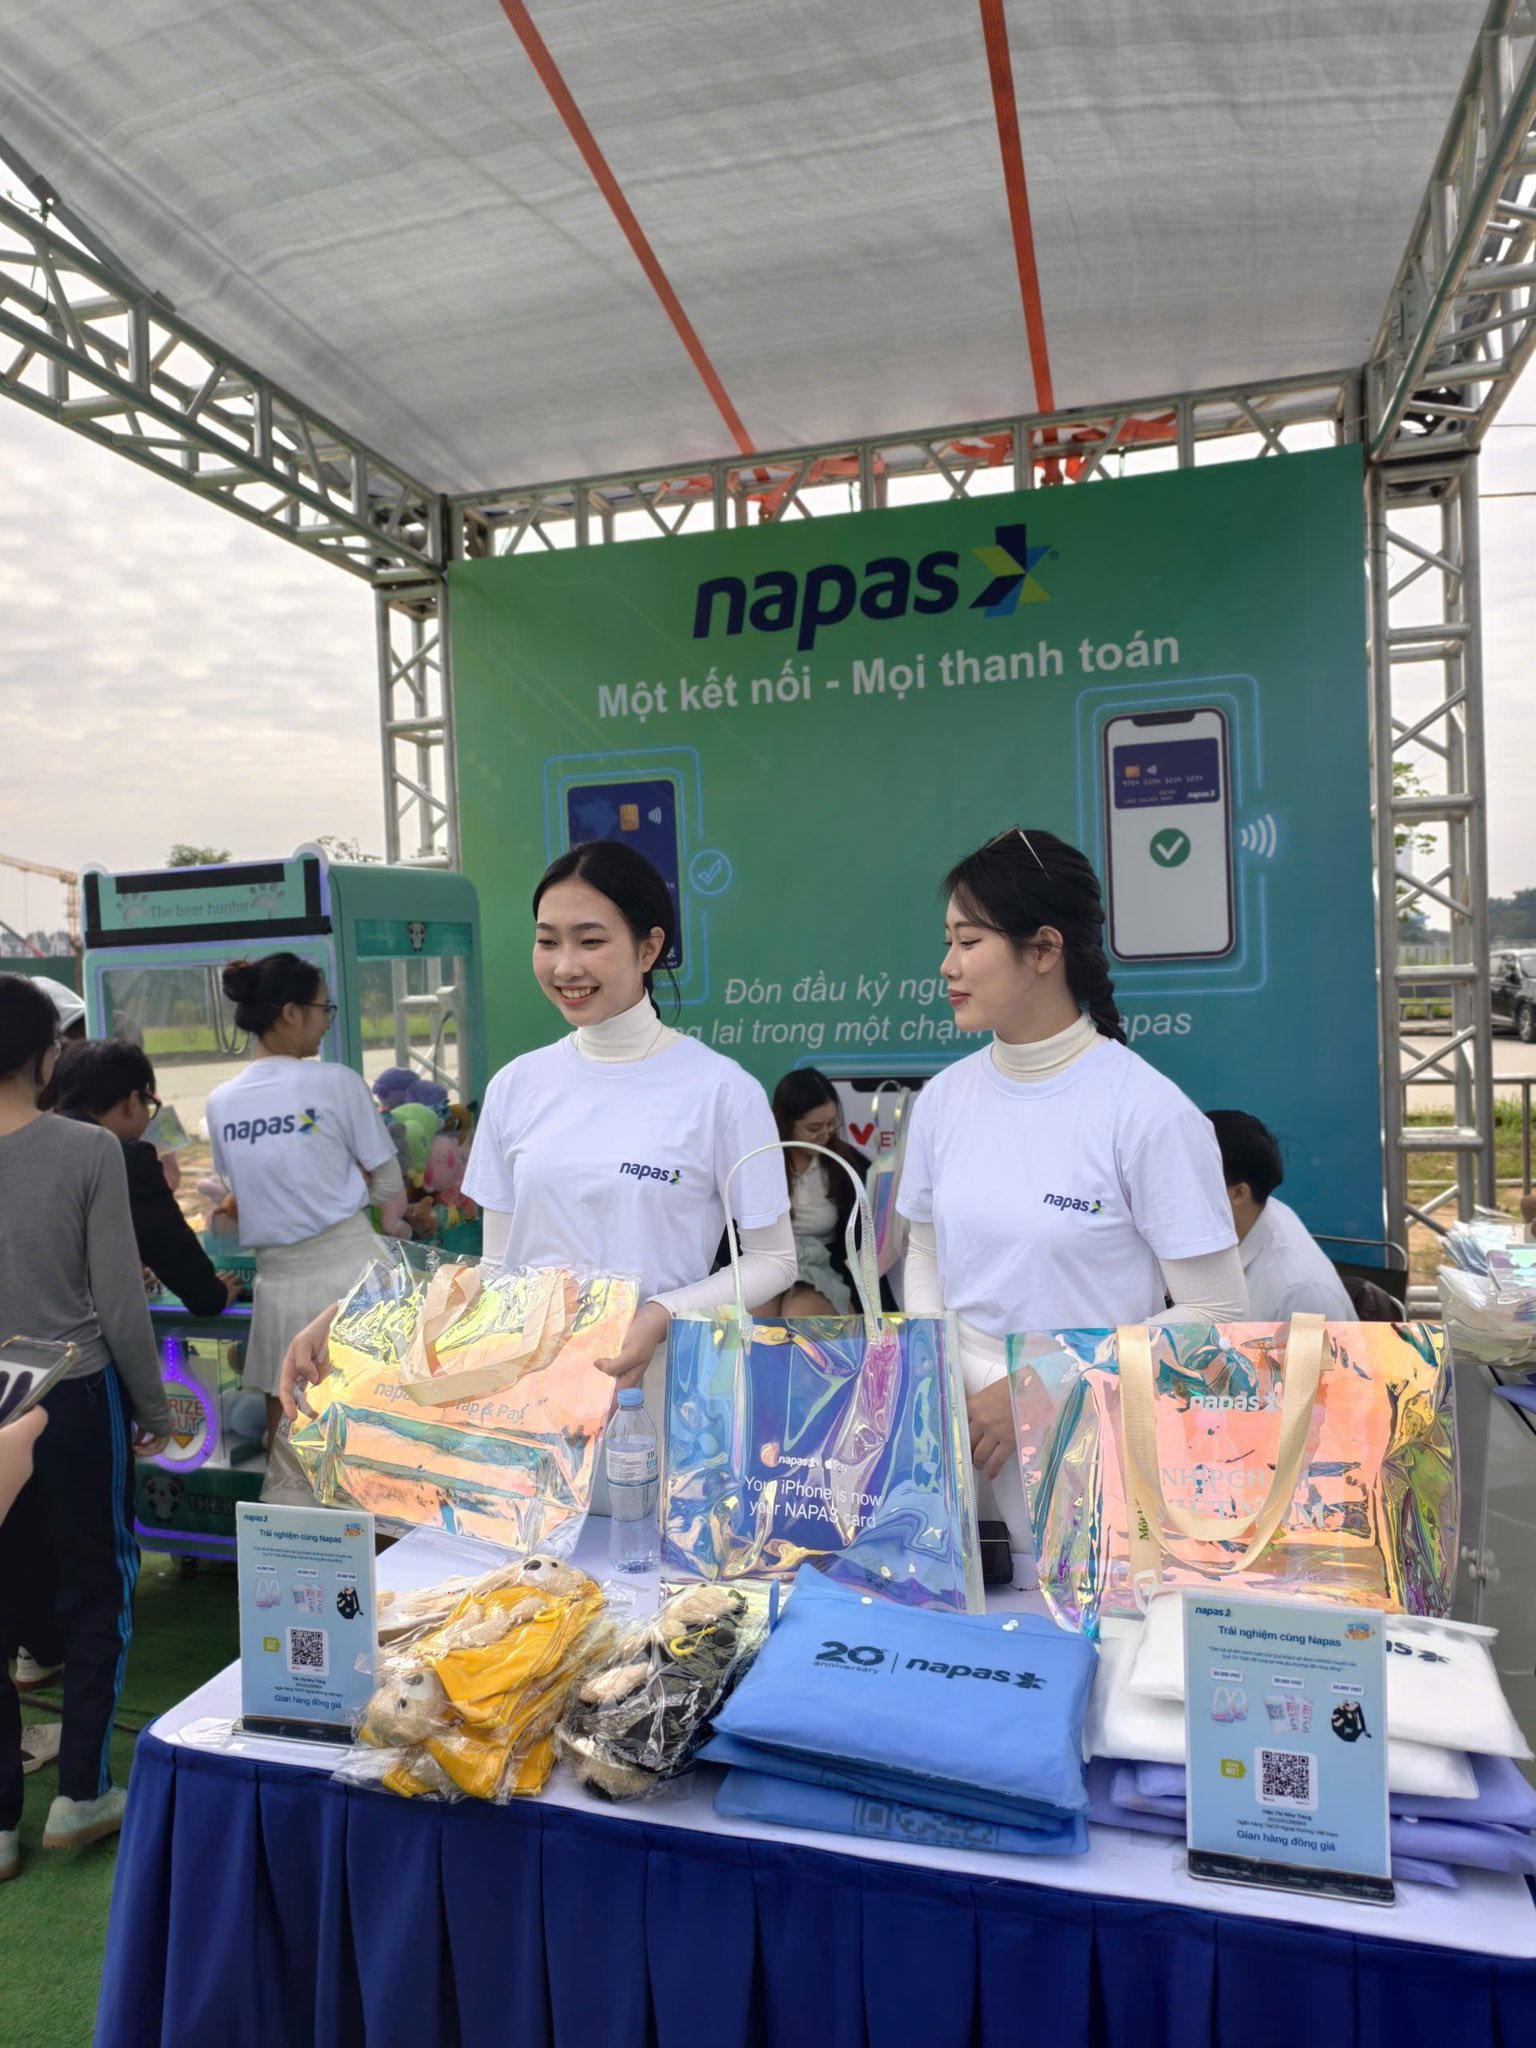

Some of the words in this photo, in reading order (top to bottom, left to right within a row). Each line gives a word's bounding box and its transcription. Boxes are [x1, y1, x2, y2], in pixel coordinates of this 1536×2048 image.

[693, 550, 961, 651] napas
[597, 681, 668, 723] Một
[679, 666, 739, 711] kết
[751, 659, 811, 704] nối
[852, 653, 926, 700] Mọi
[939, 641, 1064, 687] thanh
[1078, 629, 1180, 673] toán
[724, 977, 782, 1005] Đón
[792, 969, 846, 1003] đầu
[856, 972, 891, 1008] kỷ
[899, 977, 951, 1006] ngu
[711, 1018, 745, 1045] lai
[750, 1020, 826, 1049] trong
[834, 1015, 891, 1047] một
[1117, 1012, 1193, 1043] apas
[223, 1114, 295, 1145] napas
[619, 1162, 670, 1181] napas
[1042, 1193, 1091, 1212] napas
[168, 1398, 204, 1416] RIZE
[1190, 1394, 1260, 1417] napas
[744, 1474, 777, 1493] You
[781, 1479, 832, 1500] iPhone
[836, 1486, 848, 1501] is
[851, 1492, 882, 1507] now
[243, 1513, 263, 1523] napas
[784, 1501, 839, 1523] NAPAS
[843, 1512, 877, 1528] card
[319, 1534, 342, 1544] Napas
[1195, 1605, 1224, 1618] napas
[1217, 1624, 1238, 1637] Trải
[1239, 1627, 1278, 1641] nghiệm
[1279, 1632, 1306, 1646] cùng
[1308, 1635, 1342, 1649] Napas
[812, 1660, 881, 1675] anniversary
[905, 1658, 1011, 1683] napas
[1236, 1829, 1261, 1841] Gian
[1262, 1831, 1289, 1847] hàng
[1290, 1835, 1318, 1851] đồng
[1319, 1839, 1336, 1853] giá
